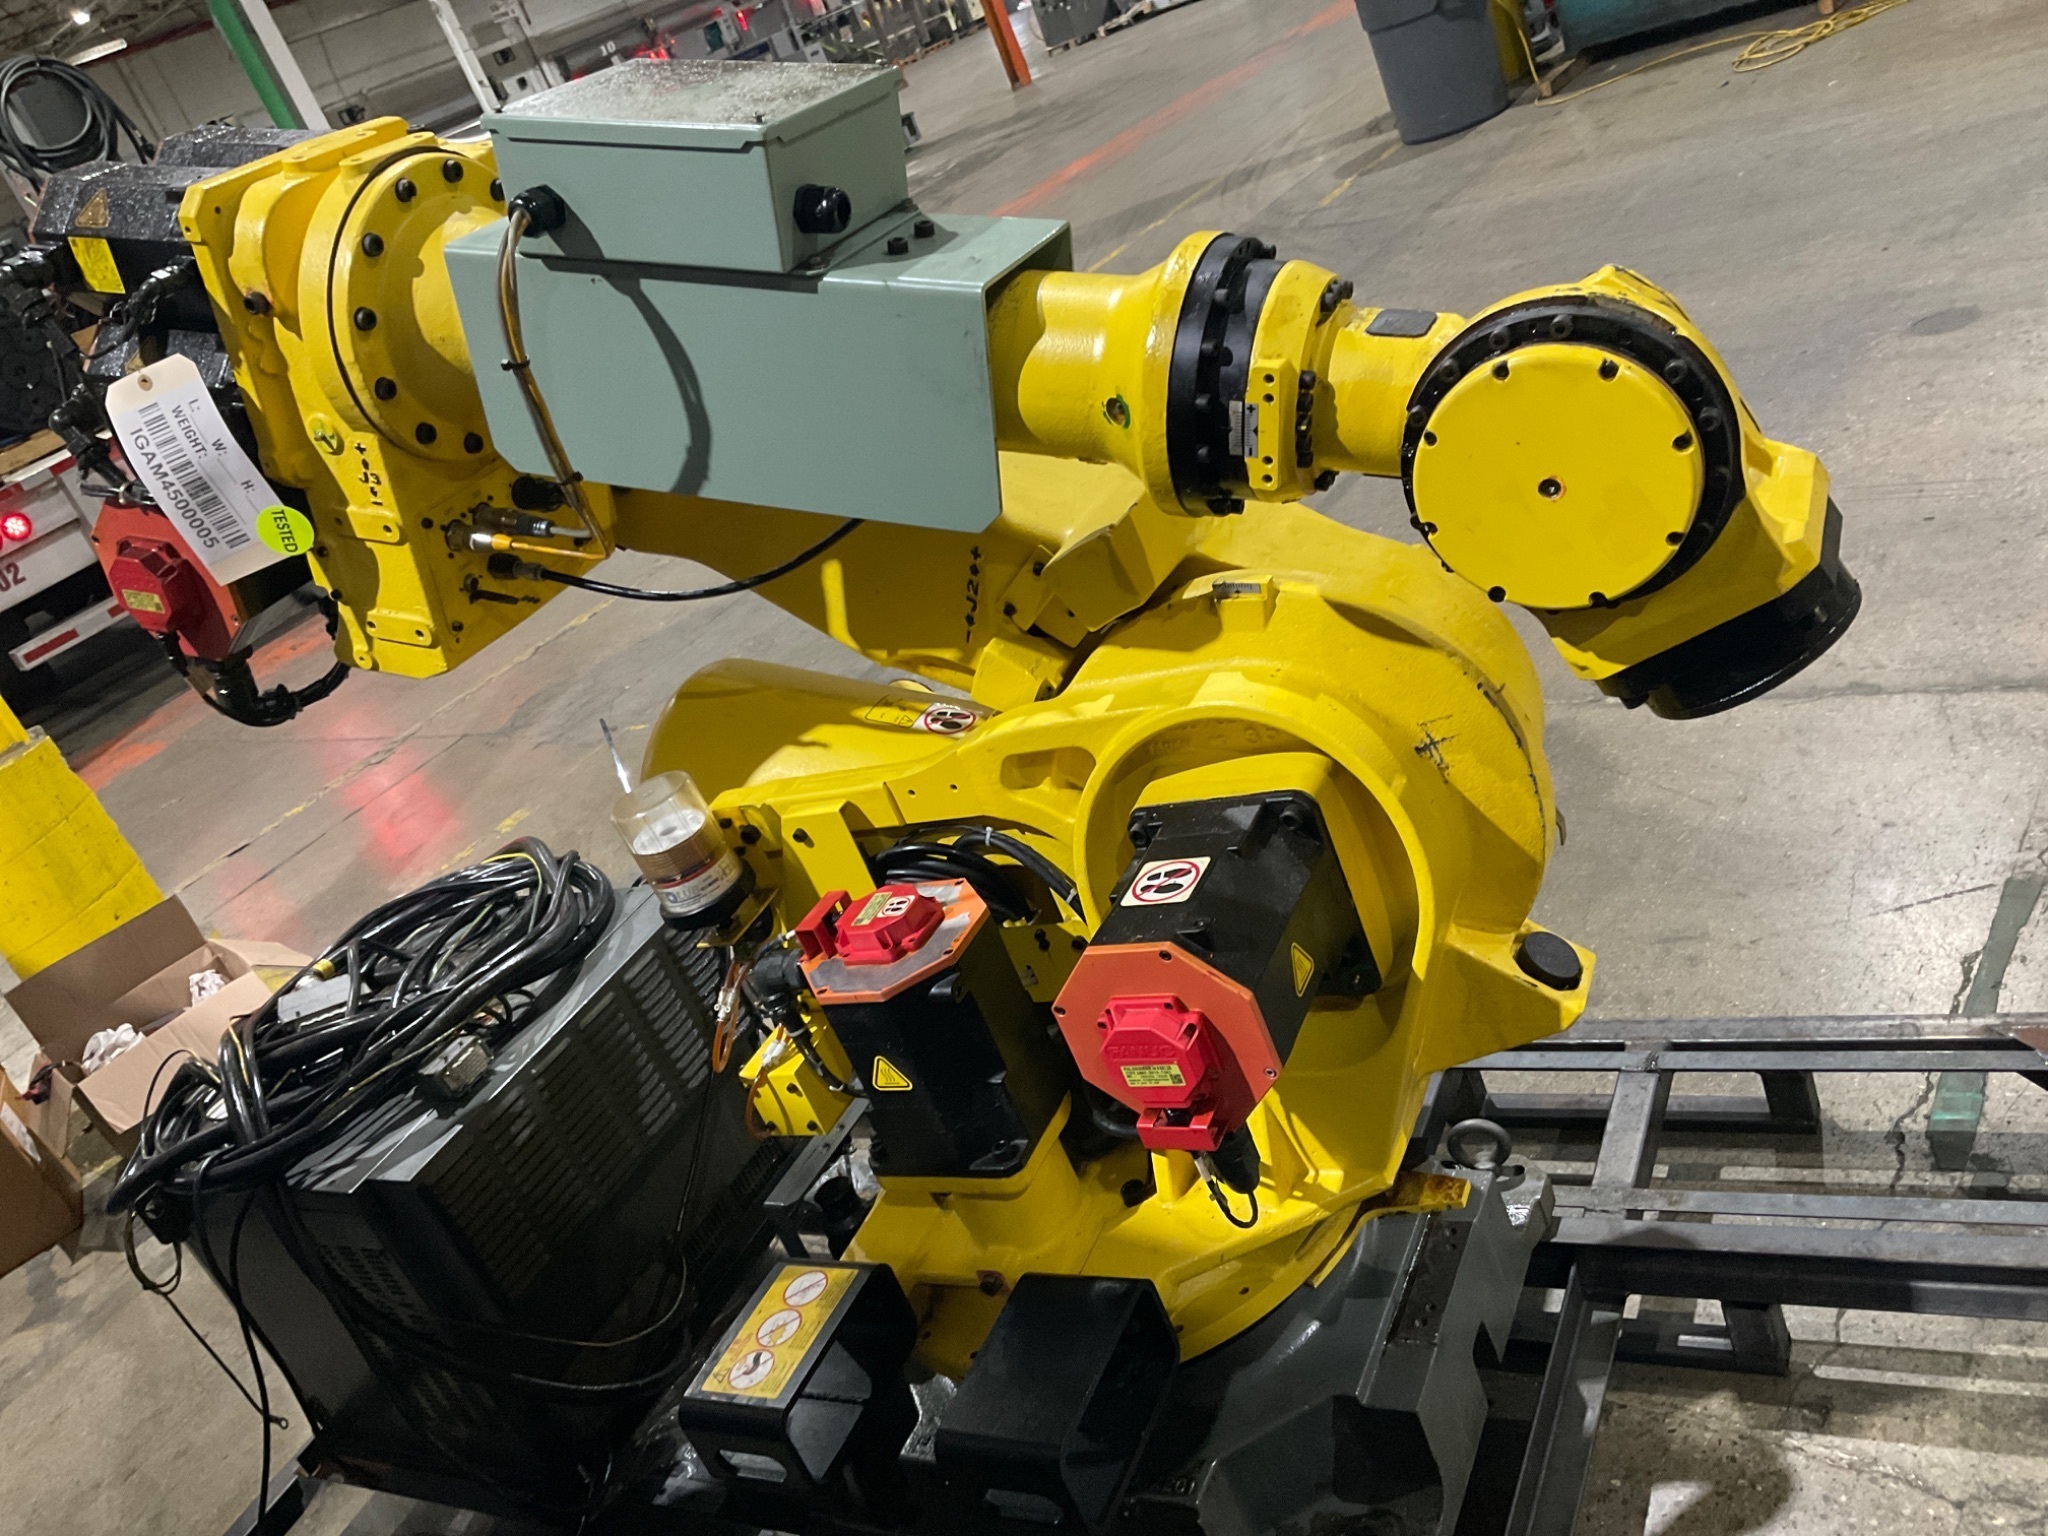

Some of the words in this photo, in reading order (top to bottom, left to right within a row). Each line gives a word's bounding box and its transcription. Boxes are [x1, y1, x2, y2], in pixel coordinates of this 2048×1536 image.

[171, 404, 208, 460] WEIGHT:
[129, 427, 220, 549] IGAM4500005
[211, 438, 228, 457] W:
[240, 480, 256, 494] H:
[271, 509, 299, 553] TESTED
